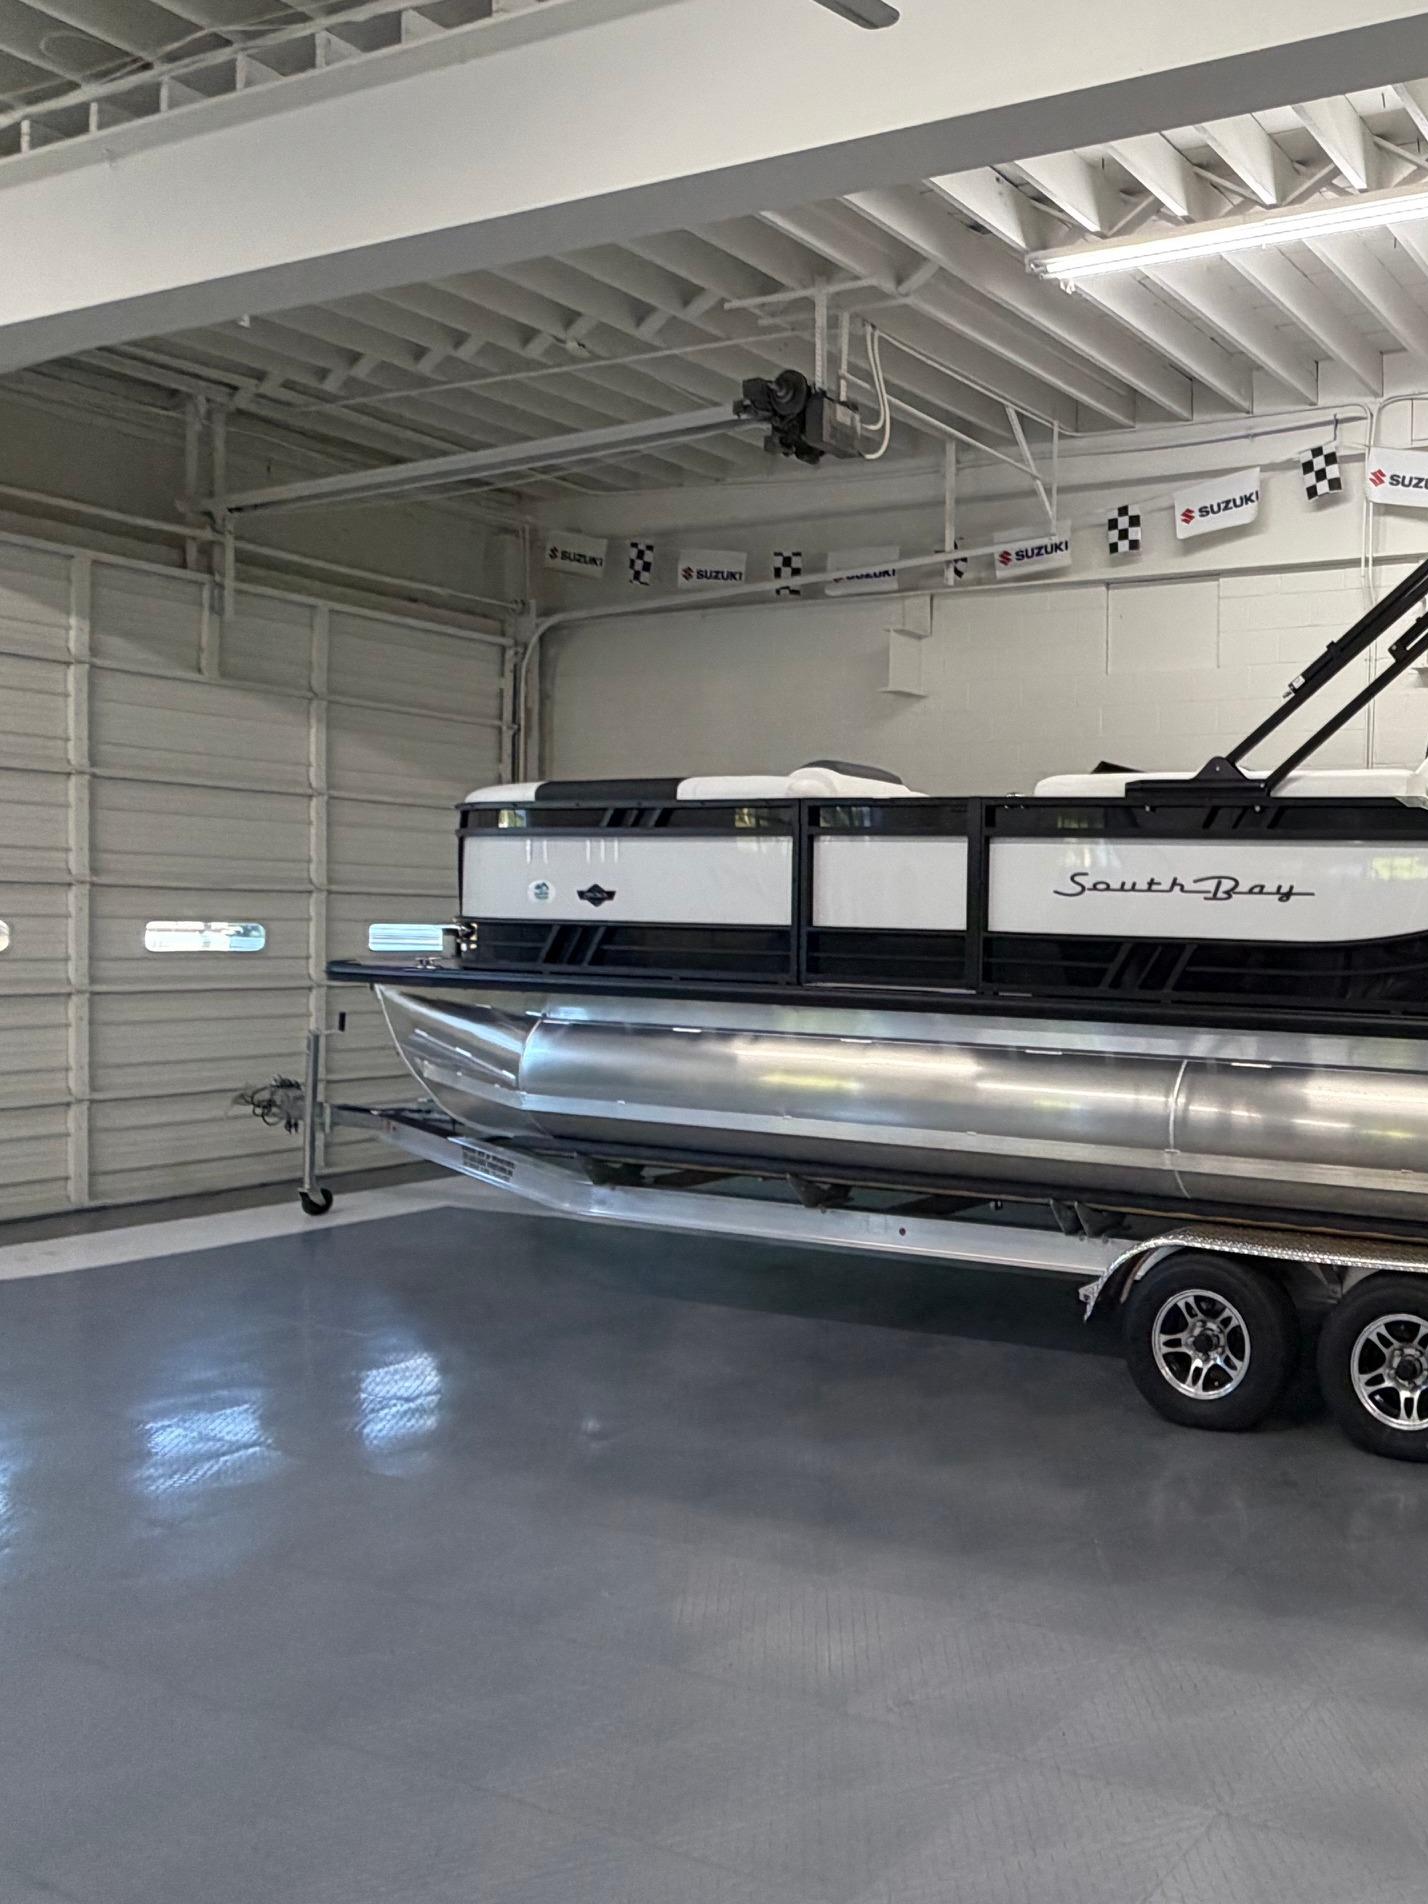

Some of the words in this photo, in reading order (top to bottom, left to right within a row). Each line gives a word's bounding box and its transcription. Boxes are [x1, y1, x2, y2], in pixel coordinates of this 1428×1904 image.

[1198, 490, 1259, 517] SUZUKI
[560, 550, 603, 567] SUZUKI
[1014, 540, 1069, 561] SUZUKI
[696, 569, 743, 581] SUZUKI
[1053, 872, 1204, 897] South
[1193, 875, 1315, 902] Bay
